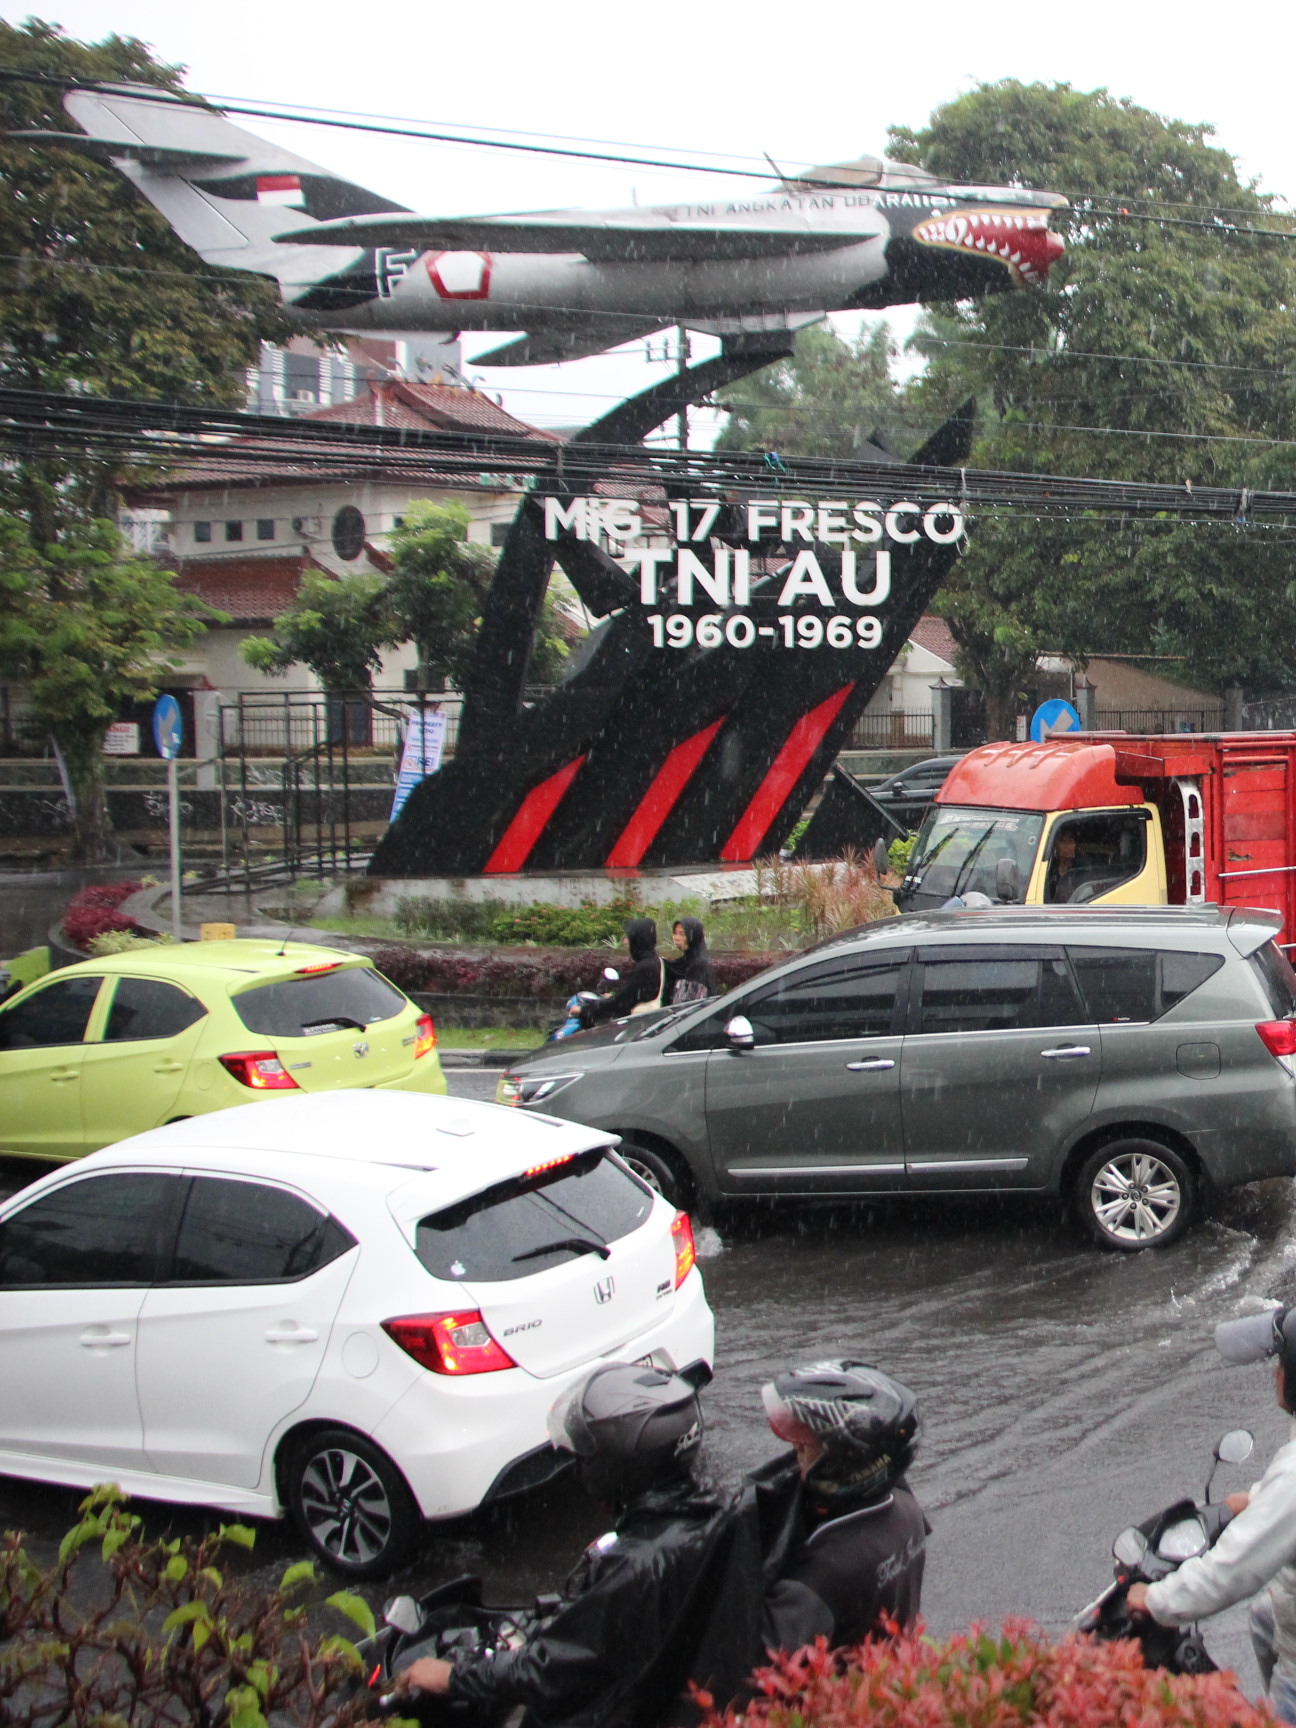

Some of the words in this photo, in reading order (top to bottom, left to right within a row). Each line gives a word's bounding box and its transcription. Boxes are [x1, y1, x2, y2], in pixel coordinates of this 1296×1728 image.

[375, 247, 417, 301] F
[668, 498, 722, 542] 17
[747, 499, 964, 545] FRESCO
[623, 548, 751, 607] TNI
[777, 549, 892, 608] AU
[646, 614, 884, 651] 1960-1969
[503, 1318, 543, 1337] BRIO
